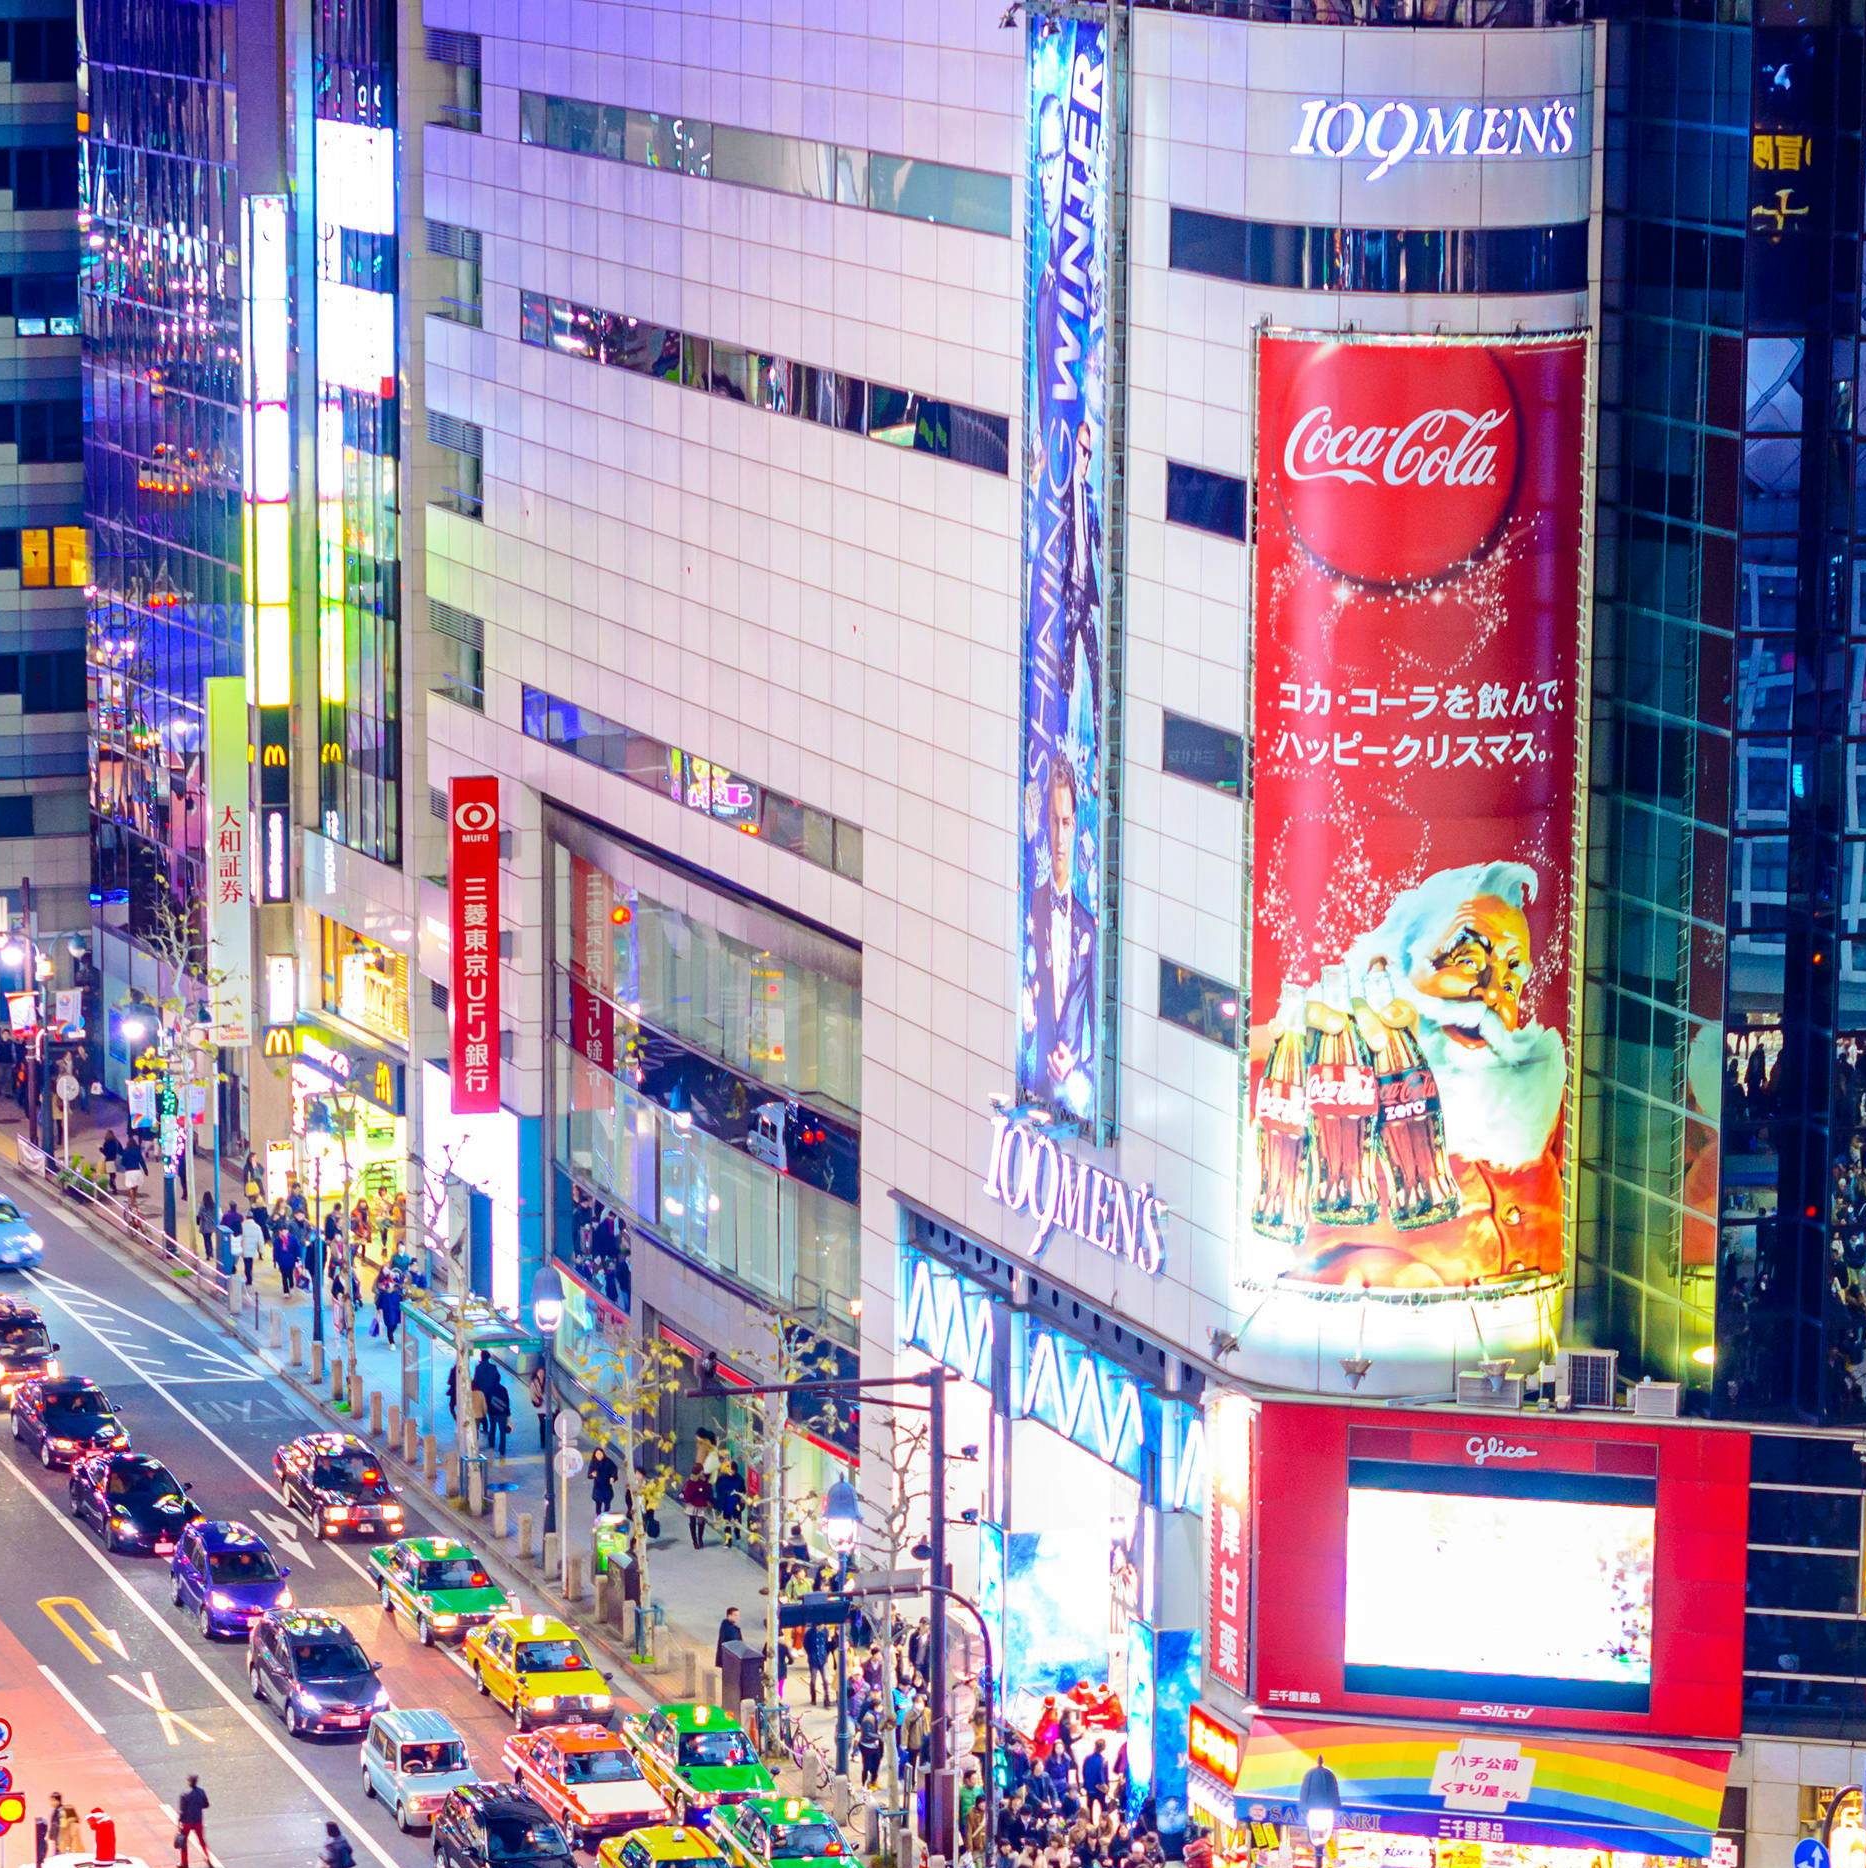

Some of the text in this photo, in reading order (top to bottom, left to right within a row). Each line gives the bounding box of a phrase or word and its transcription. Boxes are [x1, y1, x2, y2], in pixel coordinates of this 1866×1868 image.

[1052, 52, 1103, 402] WINTER
[1284, 405, 1509, 486] Coca-Cola
[1027, 418, 1075, 793] SHINING
[1278, 681, 1563, 716] コカ・コーラを飲んで、
[1276, 732, 1553, 768] ハッピークリスマス。
[462, 834, 488, 842] MUFG
[218, 805, 243, 904] 大和証券
[463, 876, 489, 1092] 三菱東京UFJ銀行
[1384, 1101, 1426, 1121] zero
[1466, 1436, 1538, 1464] Glico
[1268, 1690, 1321, 1704] 三千里薬品
[1451, 1754, 1519, 1772] ハチ公前
[1474, 1771, 1489, 1782] の
[1441, 1783, 1521, 1800] くすり屋 さん
[1438, 1819, 1505, 1841] 三千里薬品
